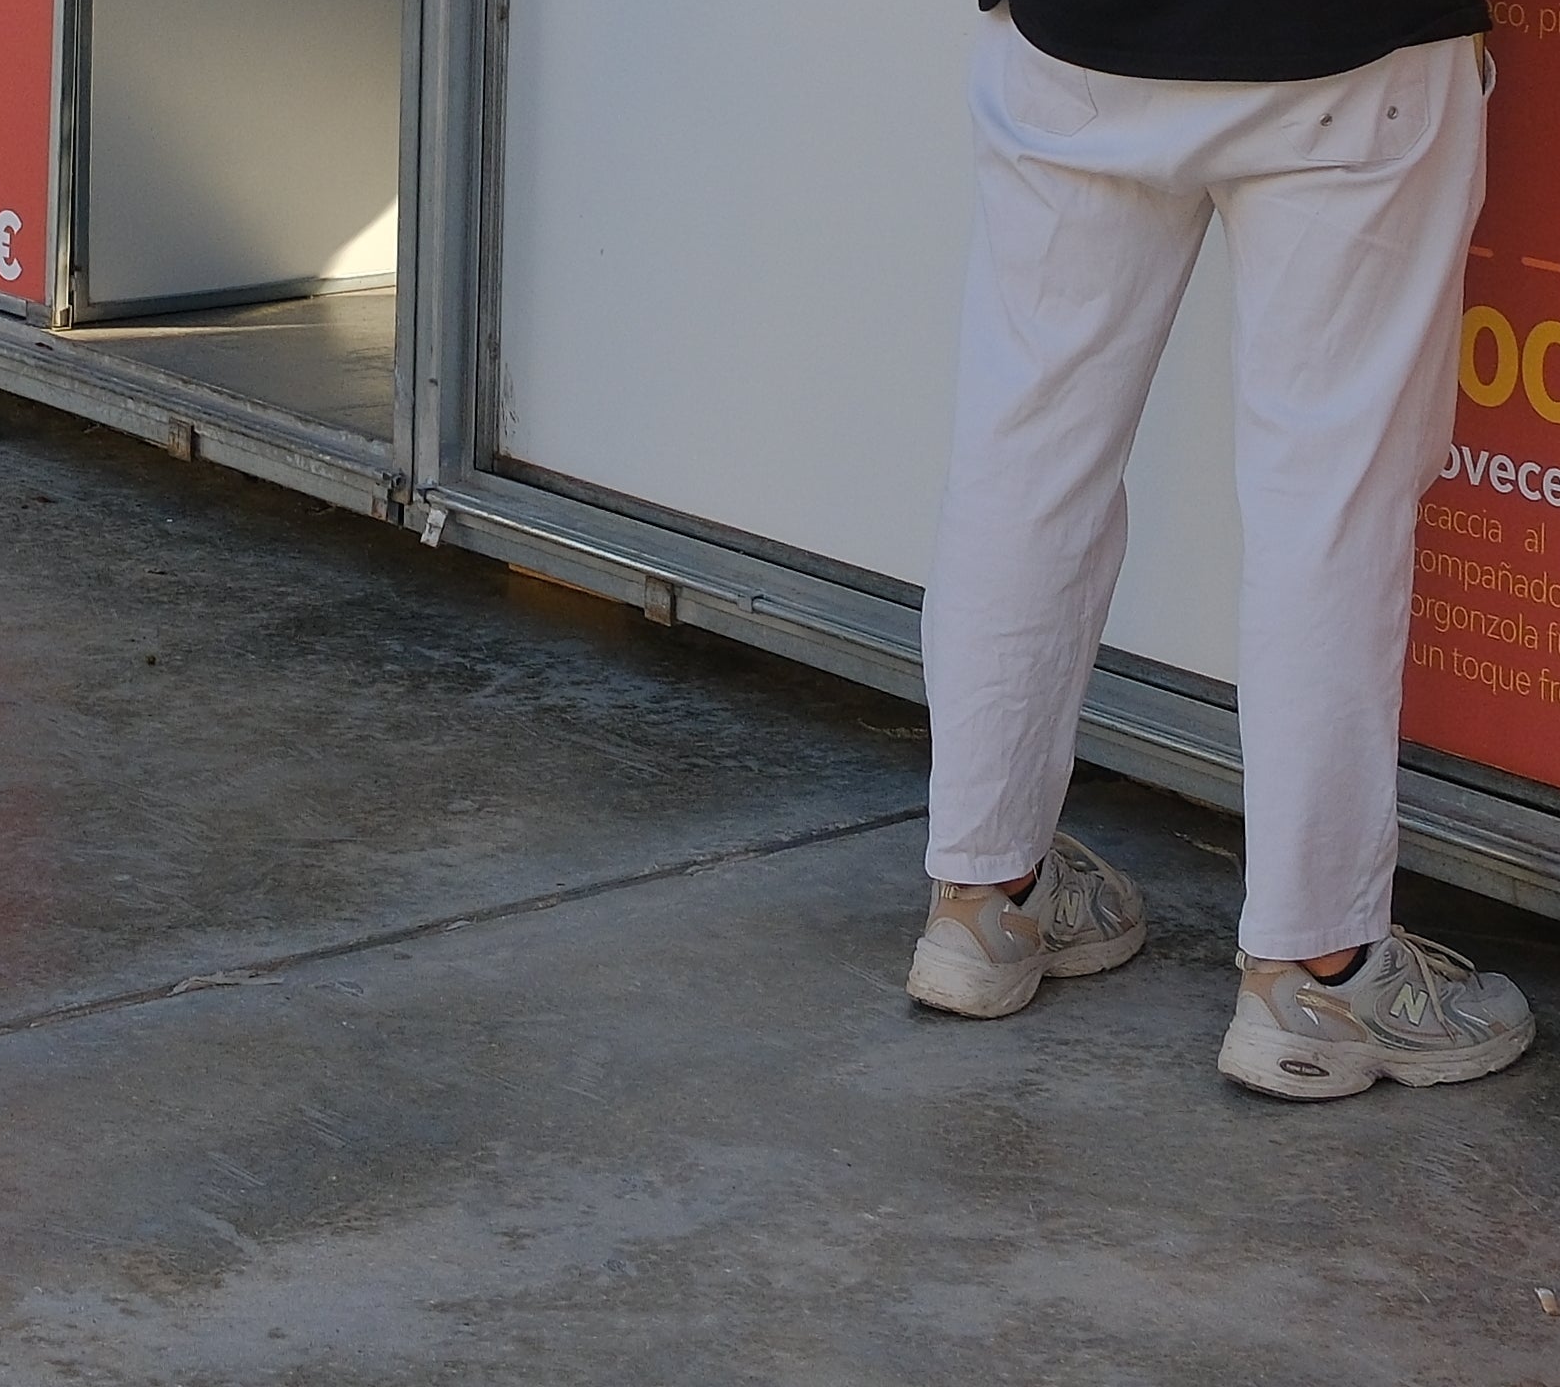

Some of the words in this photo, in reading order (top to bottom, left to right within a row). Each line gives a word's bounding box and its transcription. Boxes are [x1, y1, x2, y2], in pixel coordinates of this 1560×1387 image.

[1524, 523, 1545, 554] al
[1411, 640, 1445, 671] un
[1452, 648, 1531, 697] toque
